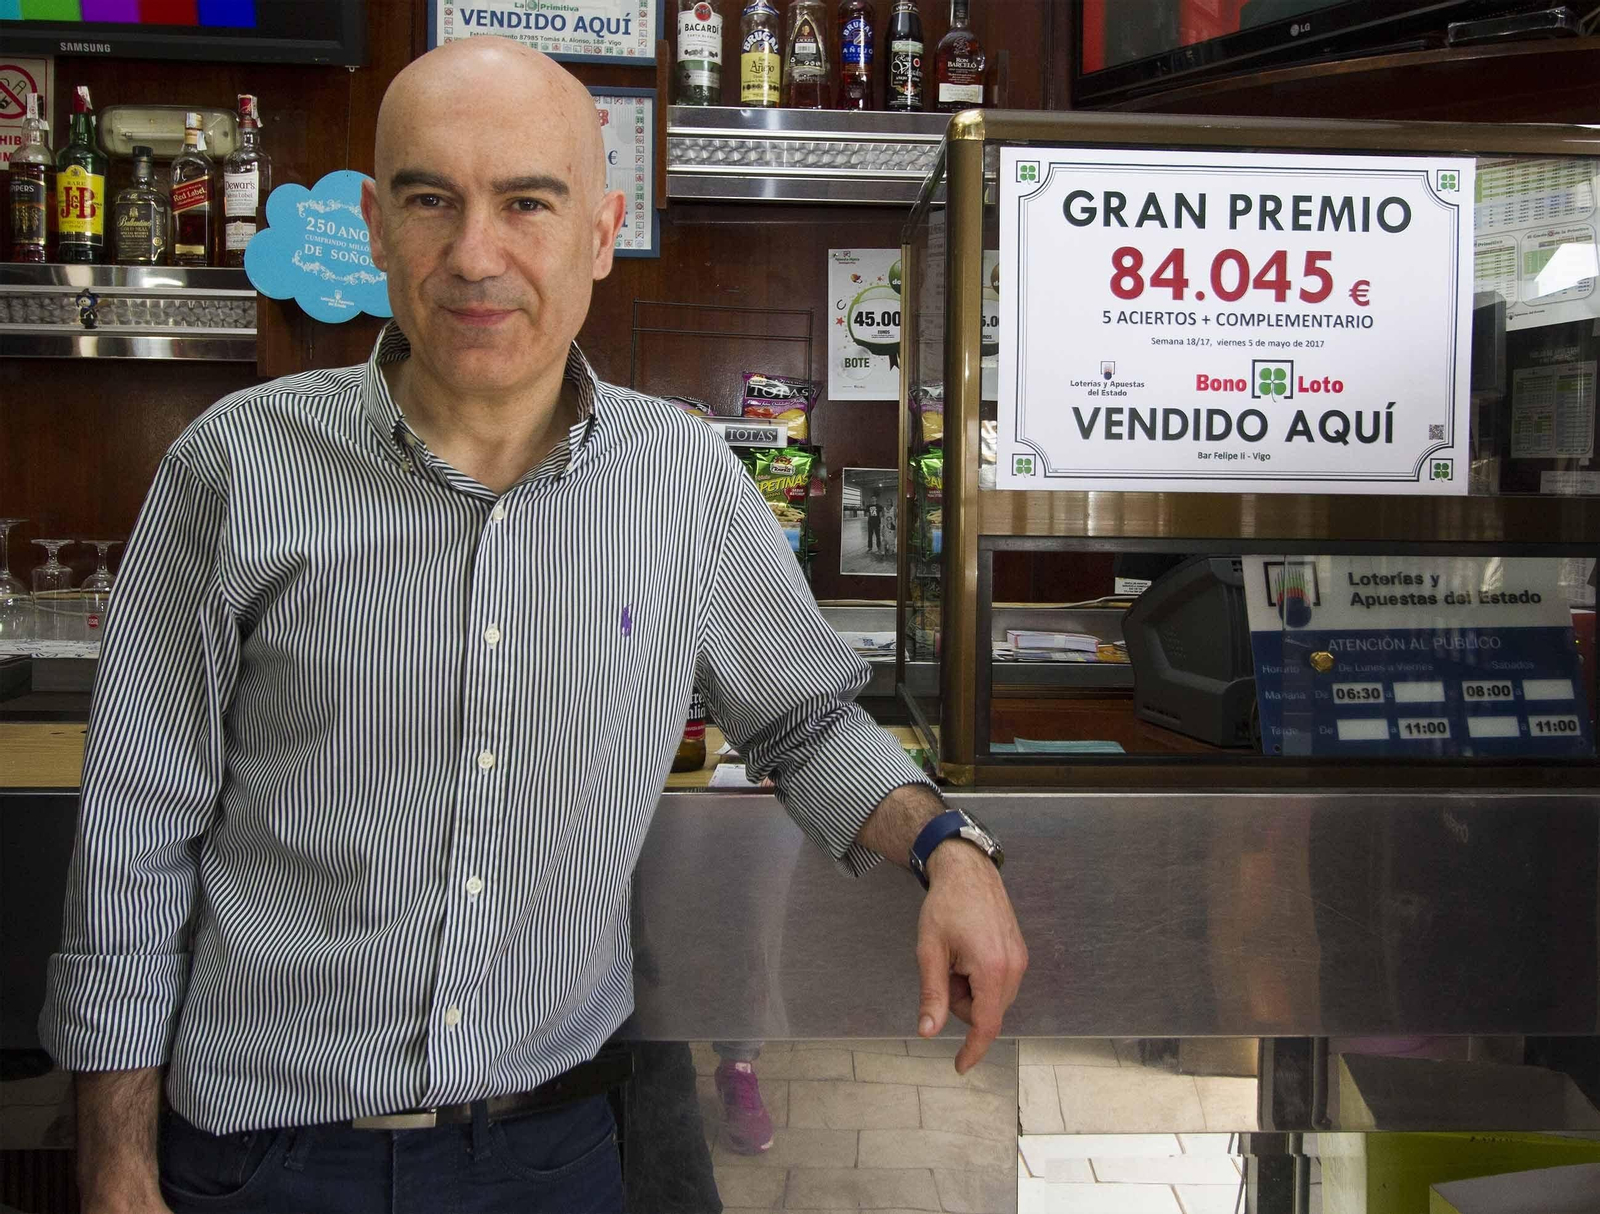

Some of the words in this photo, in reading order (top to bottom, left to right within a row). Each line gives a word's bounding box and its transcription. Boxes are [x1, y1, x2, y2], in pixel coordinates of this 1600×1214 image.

[540, 4, 579, 12] Primitiva
[460, 8, 567, 31] VENDIDO
[573, 13, 631, 38] AQUÍ
[684, 23, 719, 35] BACARDÍ
[843, 22, 873, 37] BRUGAL
[1300, 22, 1310, 33] LG
[60, 42, 111, 52] SAMSUNG
[743, 31, 779, 53] BRUGAL
[750, 61, 775, 75] Añejo
[608, 150, 618, 165] €
[226, 181, 256, 190] Dewar's
[173, 194, 187, 202] Red
[187, 187, 206, 197] Label
[61, 187, 96, 219] J&B
[1063, 190, 1206, 229] GRAN
[1229, 194, 1412, 233] PREMIO
[306, 217, 336, 235] 250
[338, 226, 370, 242] ANO
[305, 234, 347, 247] CUMPRINDO
[349, 243, 370, 252] MILLÓ
[305, 244, 323, 256] DE
[1110, 246, 1333, 304] 84.045
[1348, 279, 1370, 306] €
[854, 311, 901, 326] 45.00
[1102, 311, 1111, 325] 5
[1117, 311, 1197, 326] ACIERTOS
[1201, 315, 1211, 325] +
[1216, 312, 1374, 328] COMPLEMENTARIO
[1151, 337, 1184, 346] Semana
[1186, 338, 1213, 347] 18/17,
[1217, 339, 1246, 347] viernes
[1248, 339, 1253, 347] 5
[1255, 339, 1266, 348] de
[1267, 341, 1288, 349] mayo
[1289, 340, 1303, 348] de
[1305, 340, 1325, 348] 2017
[844, 358, 870, 368] BOTE
[1070, 379, 1101, 388] Loterías
[1110, 380, 1145, 390] Apuestas
[1196, 374, 1247, 392] Bono
[1297, 376, 1344, 393] Loto
[751, 385, 809, 398] TOTAS
[1101, 389, 1127, 397] Estado
[1071, 406, 1268, 443] VENDIDO
[1284, 402, 1397, 446] AQUÍ
[727, 429, 774, 442] TOTAS
[1197, 451, 1211, 460] Bar
[1213, 451, 1238, 462] Felipe
[1253, 452, 1271, 461] Vigo
[757, 473, 808, 492] PETINAS
[1348, 571, 1424, 586] Loterías
[1430, 573, 1441, 587] y
[1350, 591, 1438, 609] Apuestas
[1444, 590, 1472, 605] del
[1479, 589, 1542, 605] Estado
[1328, 635, 1405, 651] ATENCIÓN
[1410, 637, 1428, 650] AL
[1433, 635, 1501, 650] PÚBLICO
[1338, 663, 1349, 672] De
[1355, 664, 1385, 672] Lunes
[1397, 663, 1433, 672] Viernes
[1336, 687, 1381, 700] 06:30
[1466, 685, 1511, 697] 08:00
[1405, 722, 1446, 735] 11:00
[1536, 720, 1577, 733] 11:00
